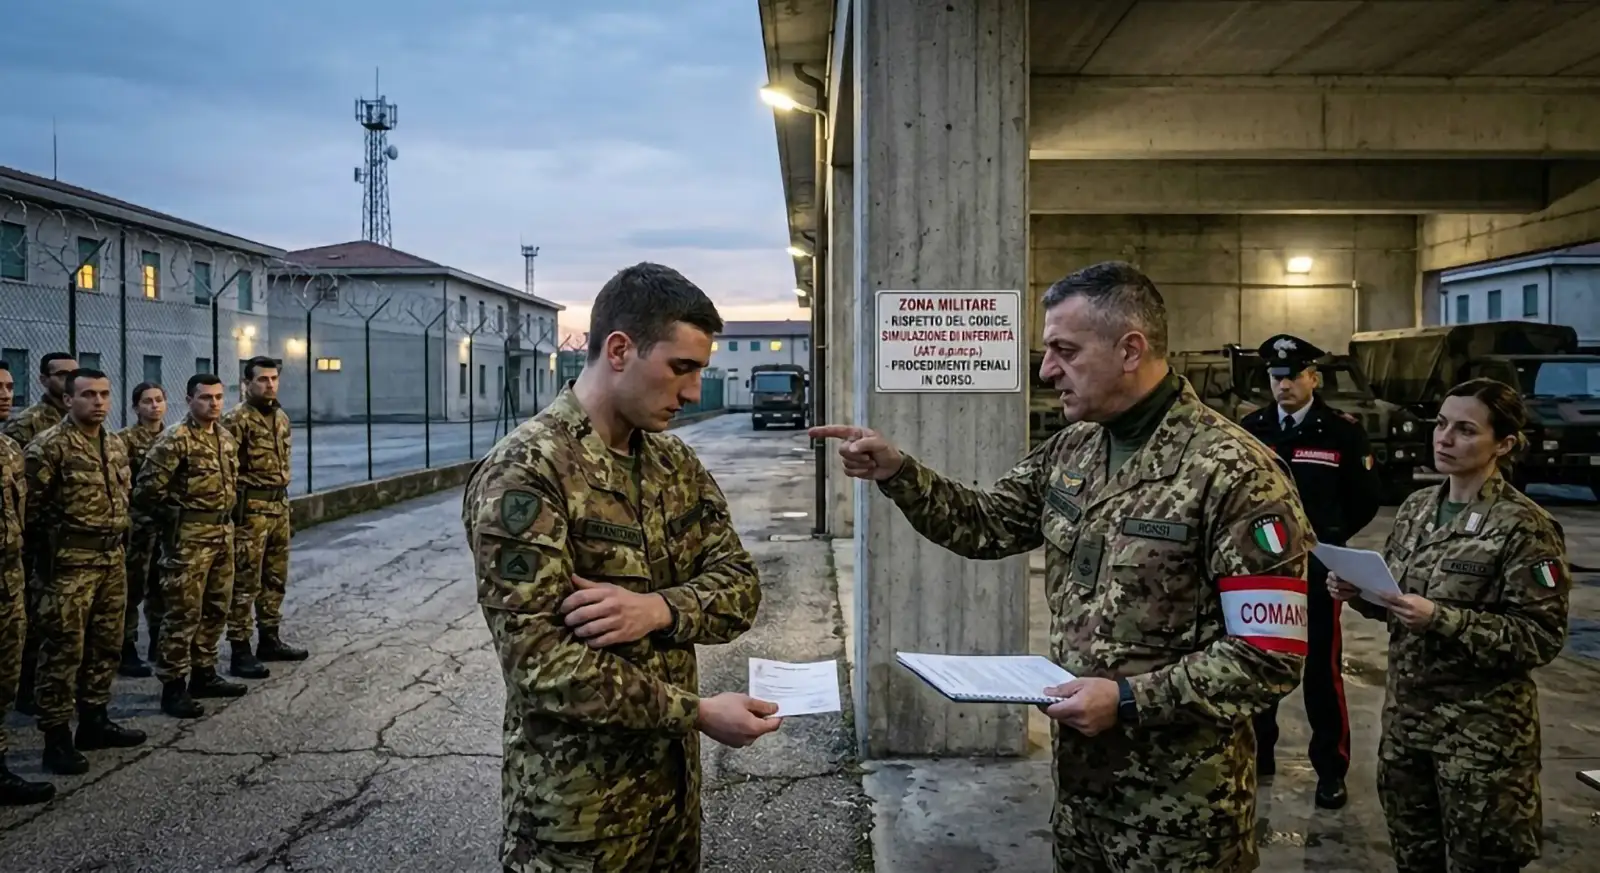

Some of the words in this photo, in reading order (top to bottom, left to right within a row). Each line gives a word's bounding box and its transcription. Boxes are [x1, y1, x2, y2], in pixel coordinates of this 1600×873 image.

[899, 298, 934, 311] ZONA
[938, 298, 997, 311] MILITARE
[891, 315, 943, 327] RISPETTO
[945, 315, 966, 327] DEL
[968, 315, 1012, 327] CODICE.
[882, 330, 946, 341] SIMULAZIONE
[949, 330, 960, 341] DI
[961, 328, 1014, 341] INFERMITÀ
[891, 359, 971, 371] PROCEDIMENTI
[973, 359, 1011, 371] PENALI
[921, 375, 933, 385] IN
[935, 374, 975, 386] CORSO.
[1241, 602, 1307, 627] COMAN
